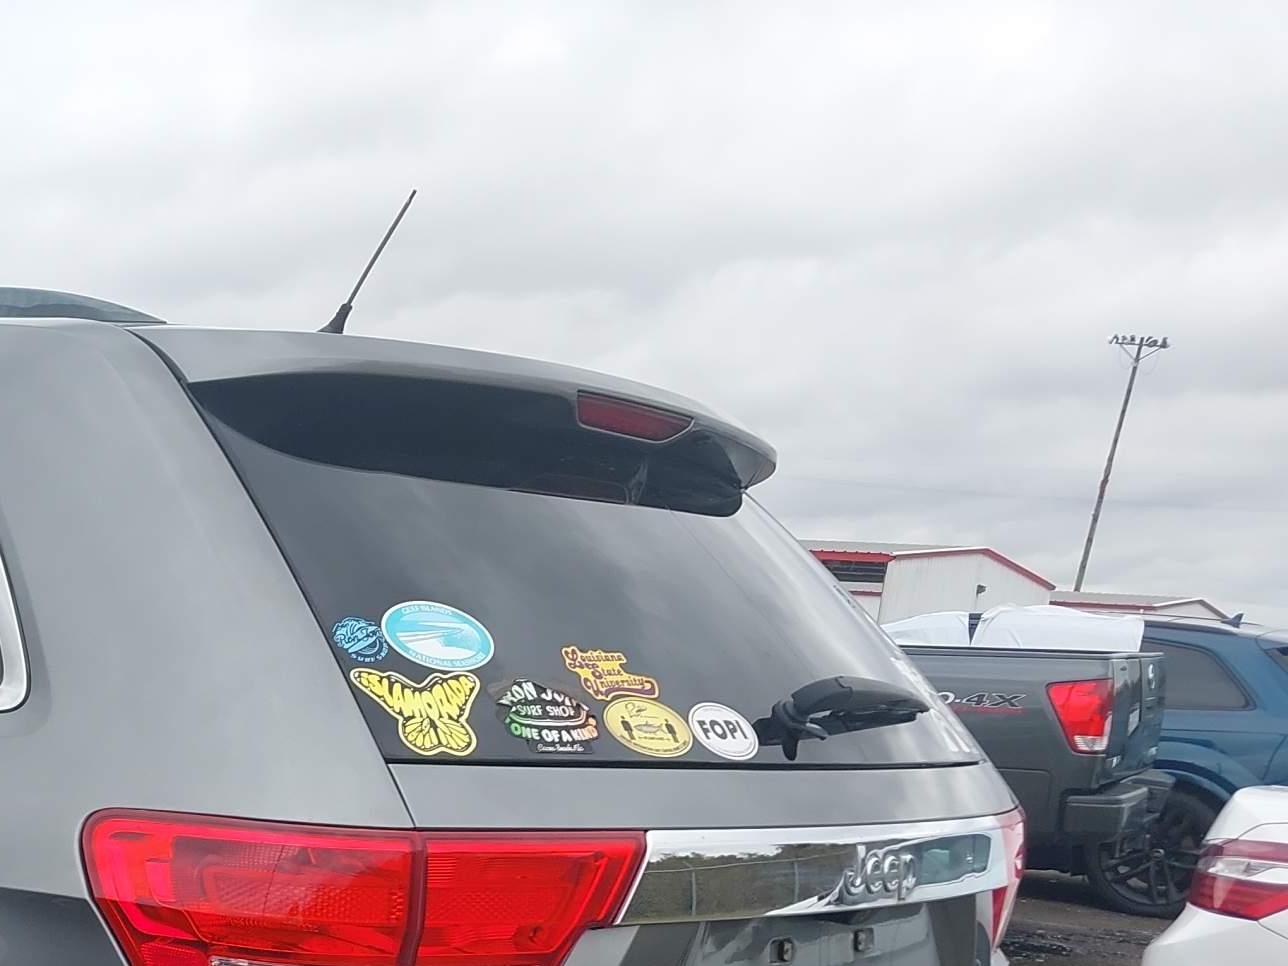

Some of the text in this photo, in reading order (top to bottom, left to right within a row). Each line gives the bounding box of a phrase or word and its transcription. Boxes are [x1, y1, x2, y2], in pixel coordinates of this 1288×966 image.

[515, 704, 543, 716] SURF
[510, 722, 541, 741] ONE
[541, 728, 561, 742] OF
[844, 844, 916, 901] Jeep
